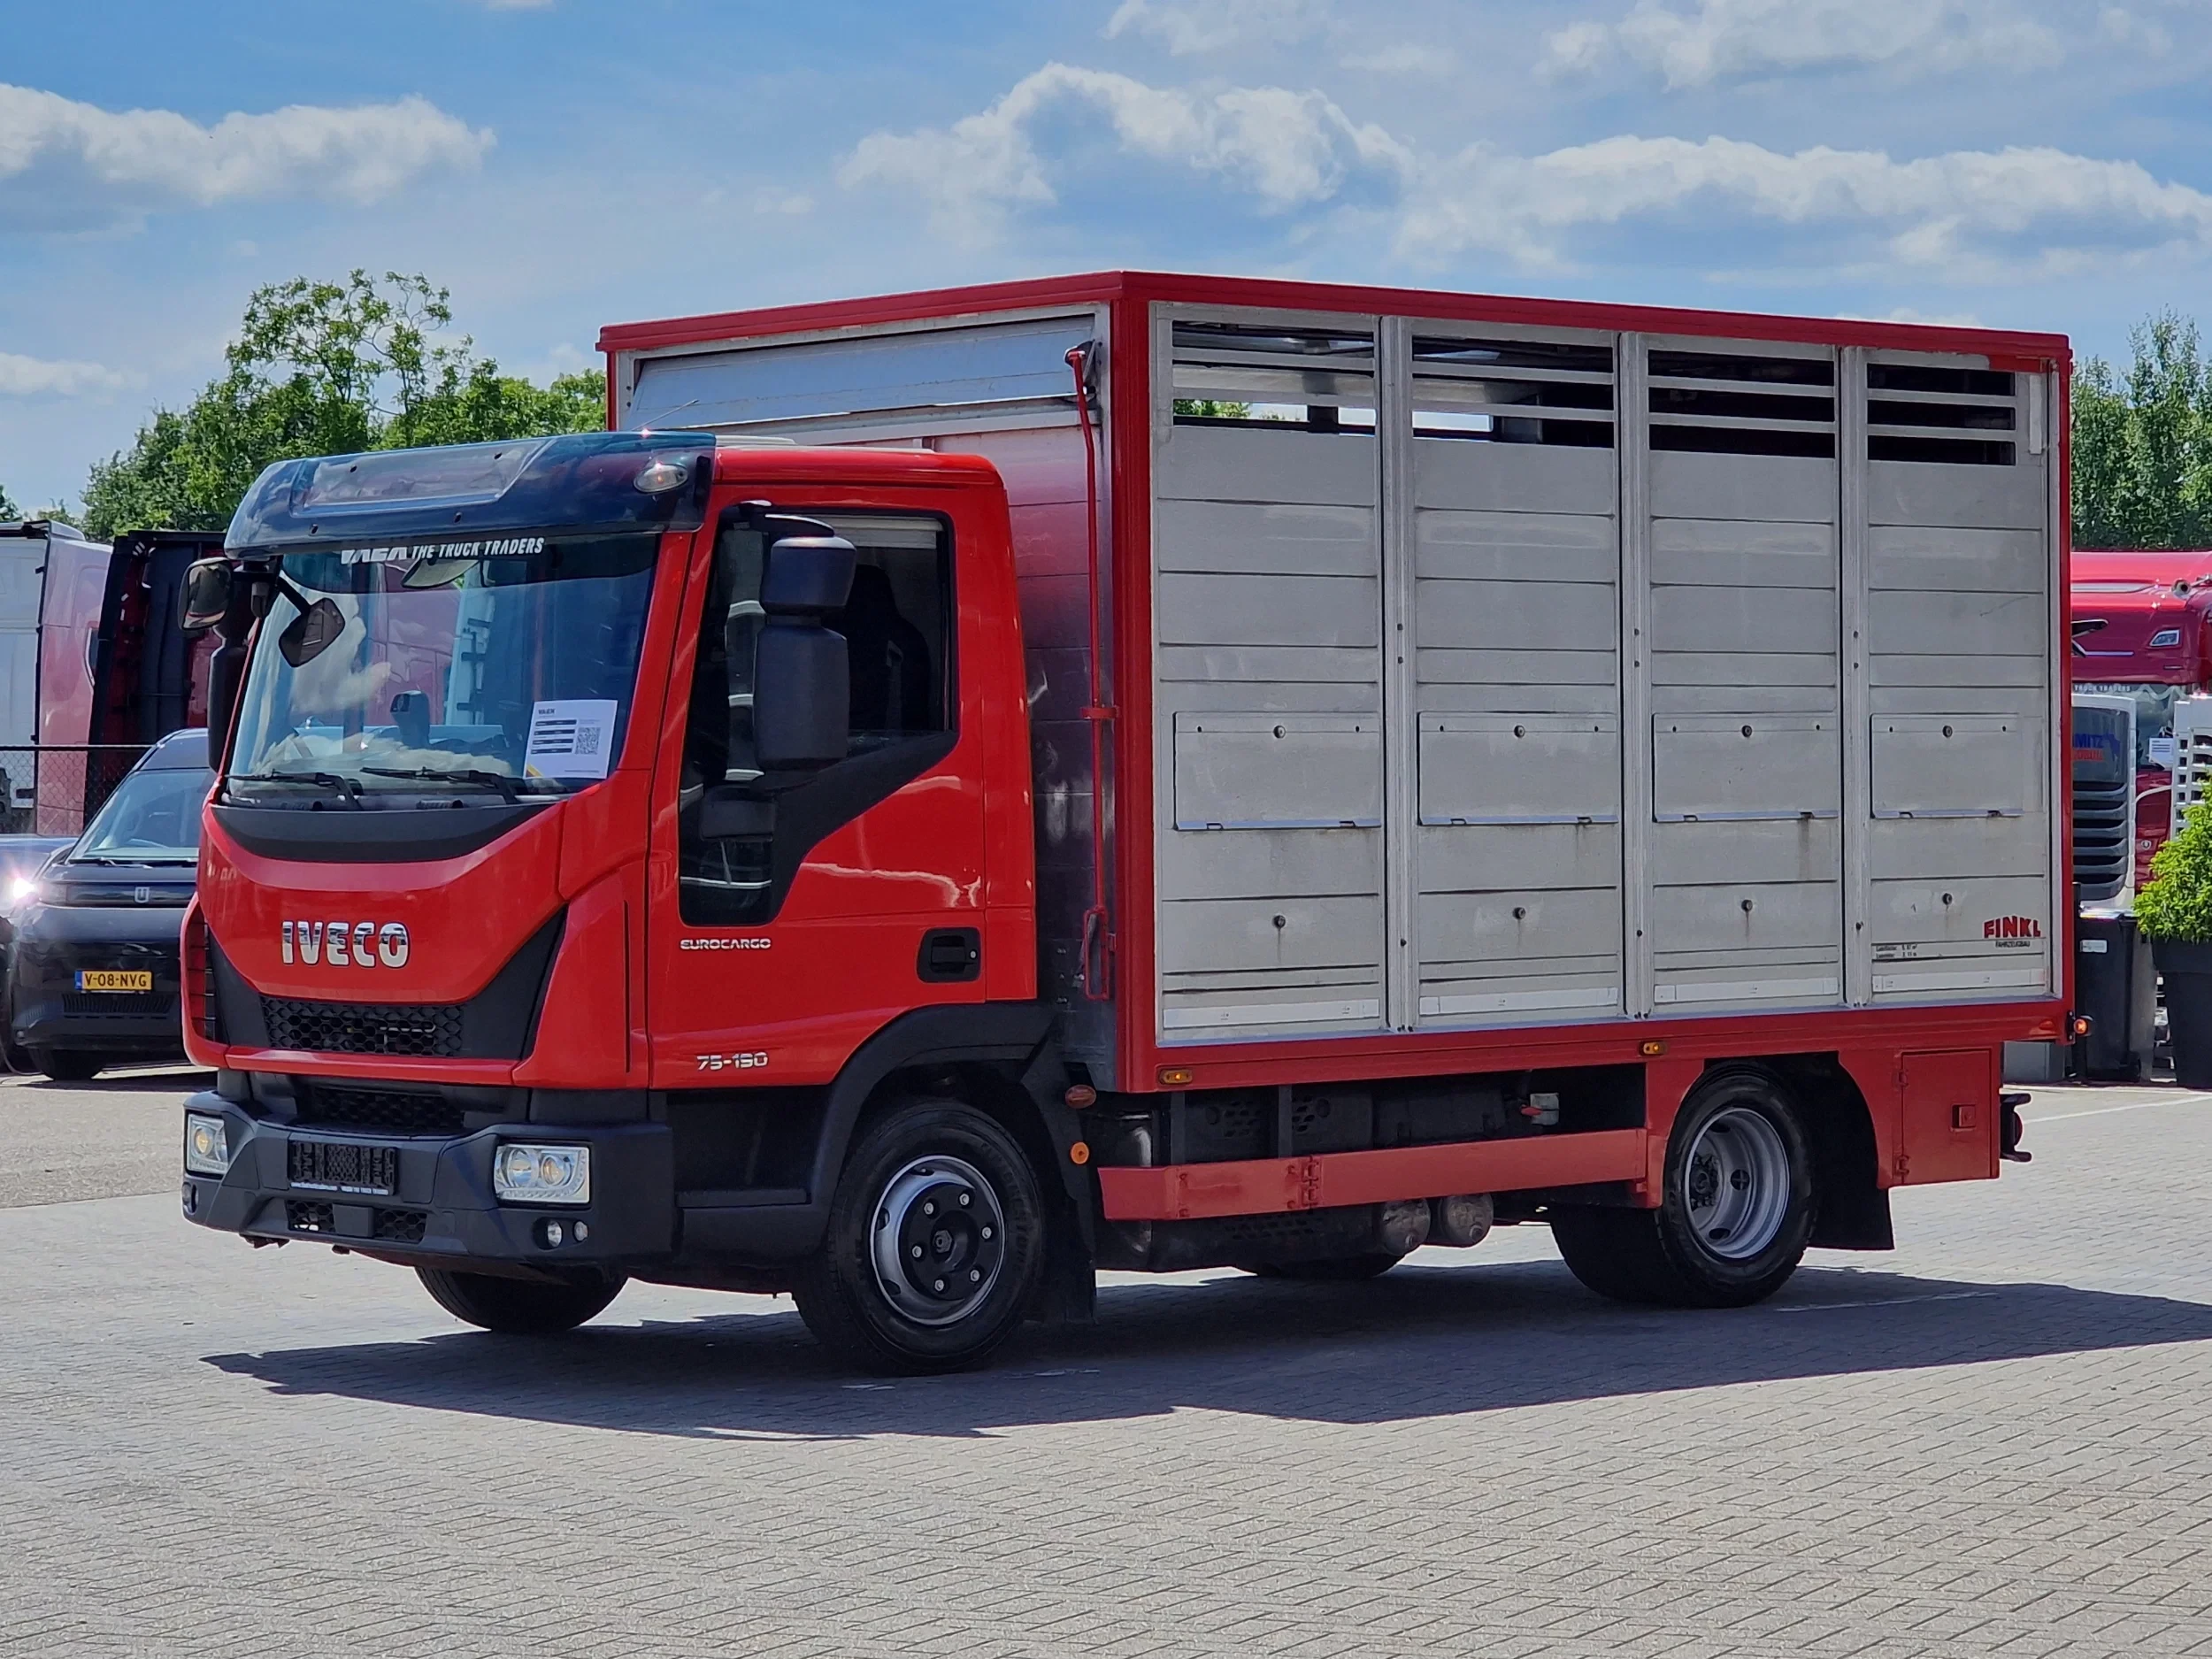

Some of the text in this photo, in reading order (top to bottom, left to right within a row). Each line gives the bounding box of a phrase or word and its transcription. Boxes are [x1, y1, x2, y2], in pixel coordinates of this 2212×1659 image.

[411, 545, 435, 560] THE
[438, 541, 480, 558] TRUCK
[484, 537, 545, 556] TRADERS
[2072, 733, 2104, 749] MITZ
[1983, 915, 2041, 939] FINKL
[281, 920, 410, 968] IVECO
[680, 938, 772, 950] EUROCARGO
[84, 973, 147, 987] V-08-NVG
